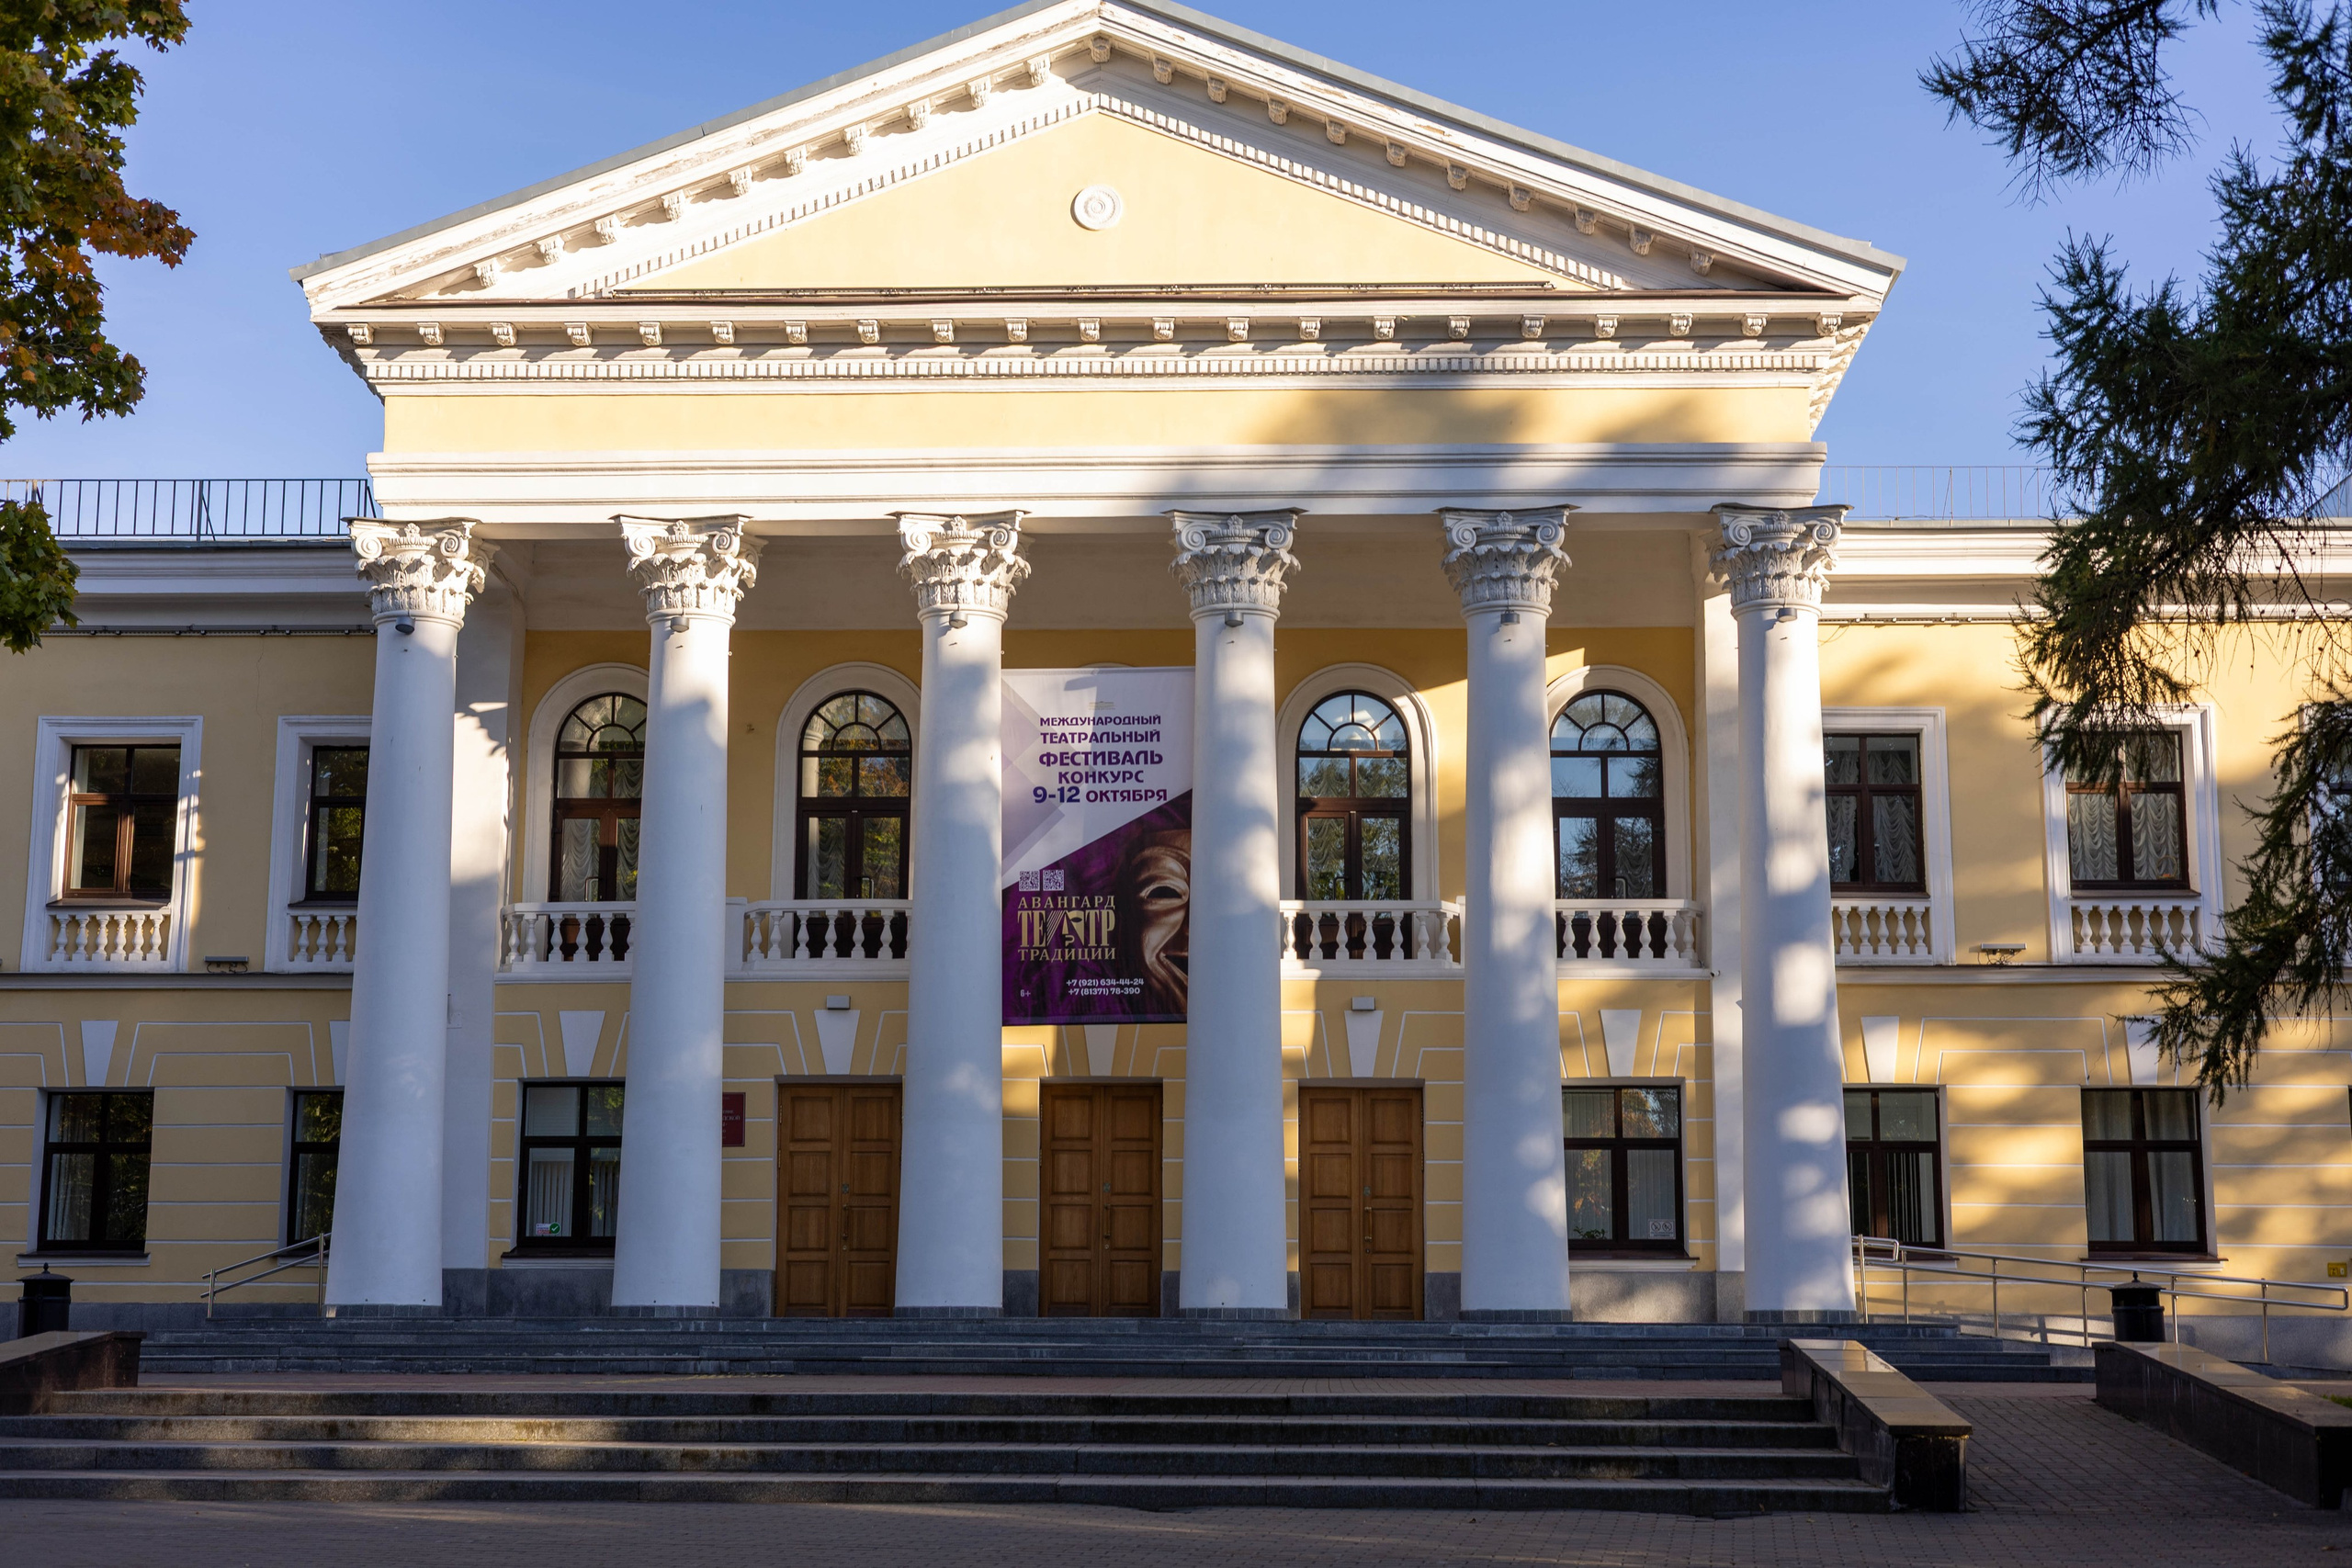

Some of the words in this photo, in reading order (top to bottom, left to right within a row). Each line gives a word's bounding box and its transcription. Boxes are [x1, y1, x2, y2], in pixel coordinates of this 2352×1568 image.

[1040, 715, 1161, 727] МЕЖДУНАРОДНЫЙ
[1040, 729, 1160, 744] ТЕАТРАЛЬНЫЙ
[1038, 750, 1163, 767] ФЕСТИВАЛЬ
[1057, 770, 1145, 784] КОНКУРС
[1033, 785, 1080, 804] 9-12
[1085, 789, 1168, 803] ОКТЯБРЯ
[1018, 895, 1115, 909] АВАНГАРД
[1017, 909, 1116, 948] ТЕАТР
[1017, 947, 1116, 963] ТРАДИЦИИ
[1079, 978, 1099, 987] (921)
[1100, 977, 1145, 987] 634-44-24
[1080, 987, 1109, 997] (81371)
[1110, 987, 1141, 995] 78-390
